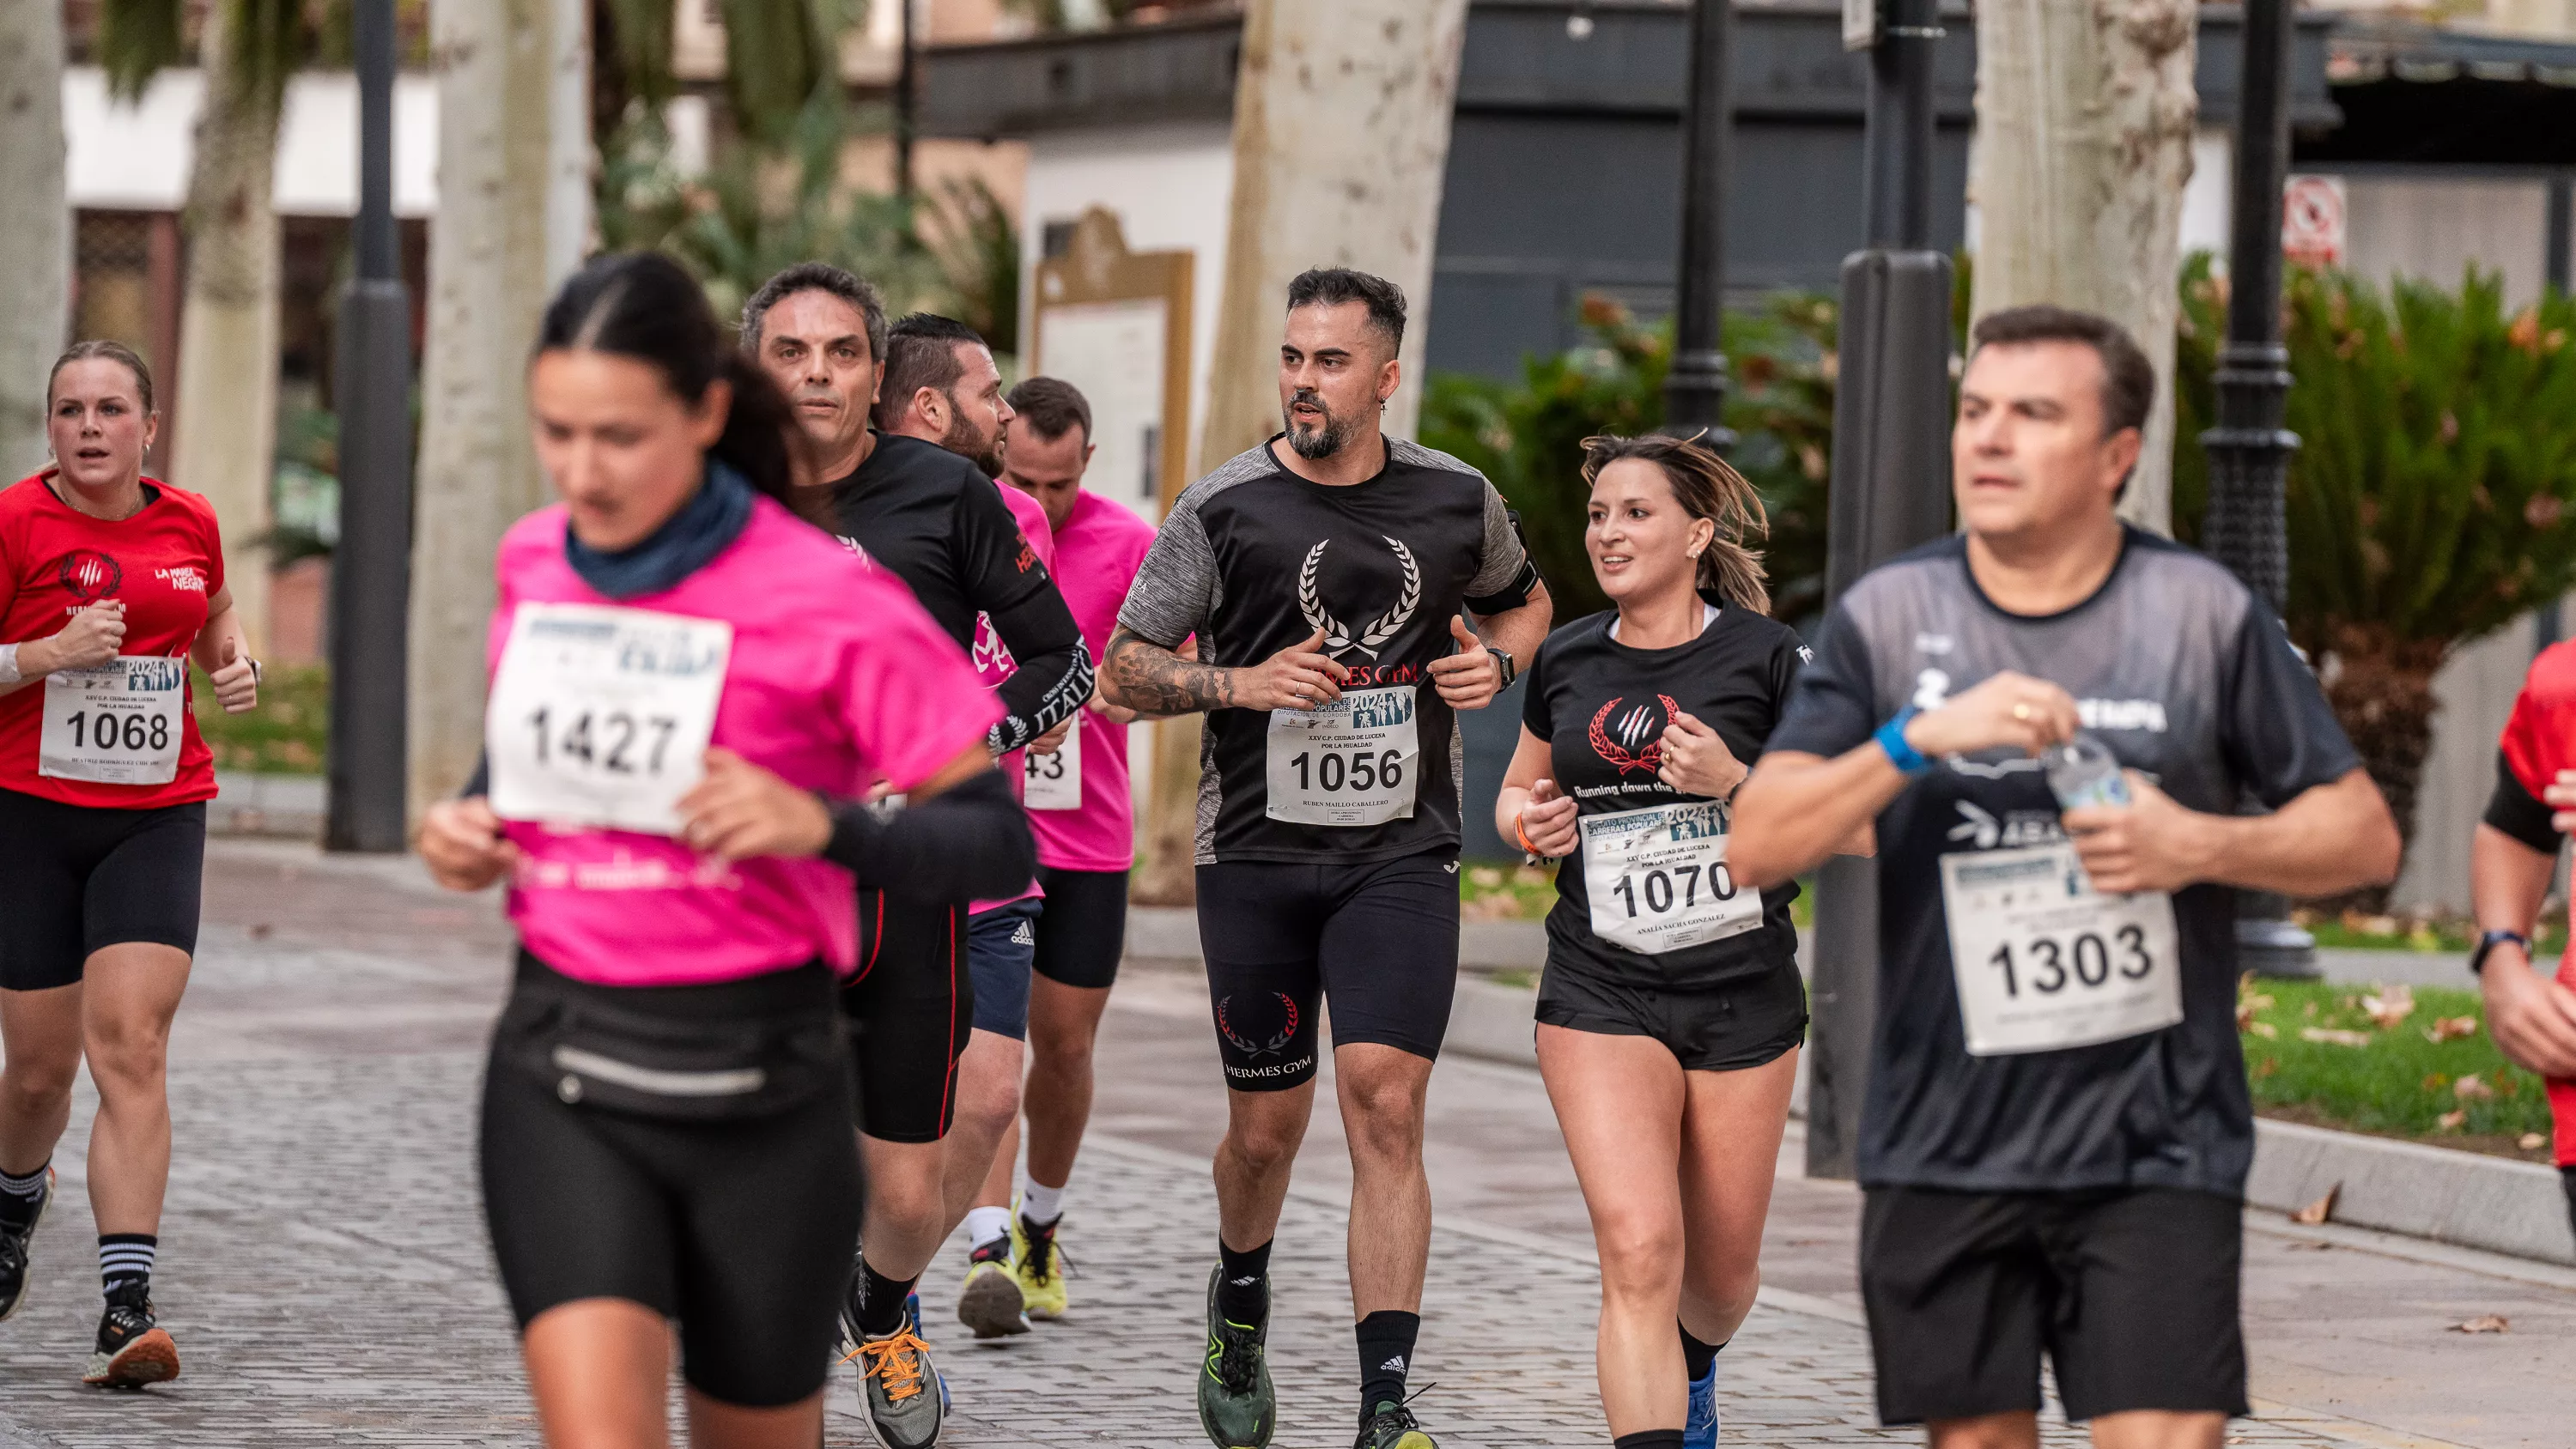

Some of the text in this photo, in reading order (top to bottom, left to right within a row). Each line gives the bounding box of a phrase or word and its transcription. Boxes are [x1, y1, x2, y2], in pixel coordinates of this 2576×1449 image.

[155, 568, 169, 579] LA
[129, 660, 161, 676] 2024
[1352, 692, 1388, 712] 2024
[66, 710, 168, 750] 1068
[526, 705, 678, 777] 1427
[1291, 749, 1402, 791] 1056
[1574, 785, 1619, 798] Running
[1653, 781, 1673, 792] the
[1588, 818, 1618, 828] CIRCUITO
[1618, 813, 1656, 824] PROVINCIAL
[1666, 803, 1710, 826] 2024
[1588, 818, 1666, 836] CARRERAS POPULARES
[1626, 853, 1640, 863] XXV
[1653, 849, 1676, 858] CIUDAD
[1665, 854, 1697, 864] IGUALDAD
[1613, 860, 1738, 919] 1070
[1637, 925, 1662, 935] ANALÍA
[1663, 921, 1687, 930] SACHA
[1988, 923, 2153, 997] 1303
[1225, 1055, 1312, 1078] HERMES GYM
